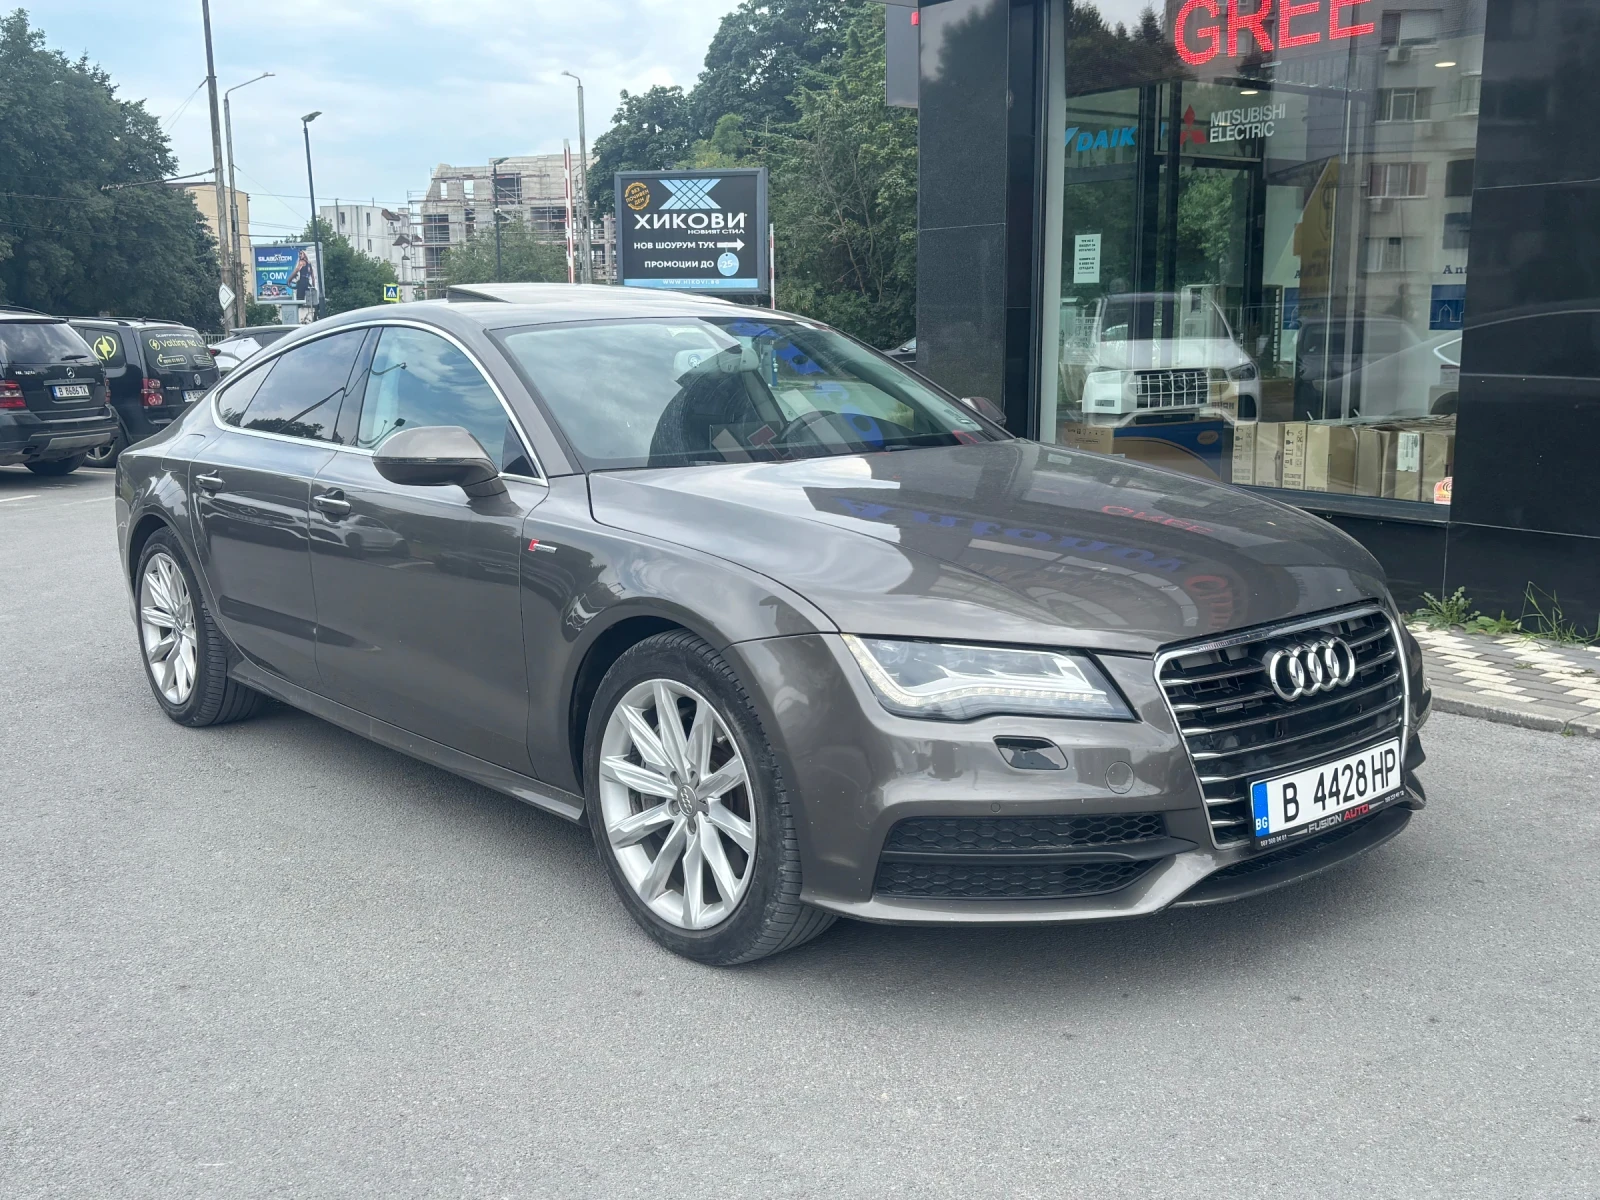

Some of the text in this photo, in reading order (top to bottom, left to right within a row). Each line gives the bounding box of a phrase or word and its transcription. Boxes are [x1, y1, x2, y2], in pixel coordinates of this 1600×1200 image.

[1174, 0, 1376, 66] GREE
[1210, 102, 1287, 127] MITSUBISHI
[1209, 121, 1275, 144] ELECTRIC
[634, 212, 745, 230] ХИКОВИ
[634, 241, 715, 250] НОВ ШОУРУМ ТУК
[644, 260, 714, 270] ПРОМОЦИИ ДО
[269, 271, 288, 280] OMV
[58, 387, 64, 396] B
[1282, 747, 1396, 824] B 4428 HP
[1255, 815, 1268, 831] BG
[1308, 803, 1370, 834] FUSION AUTO
